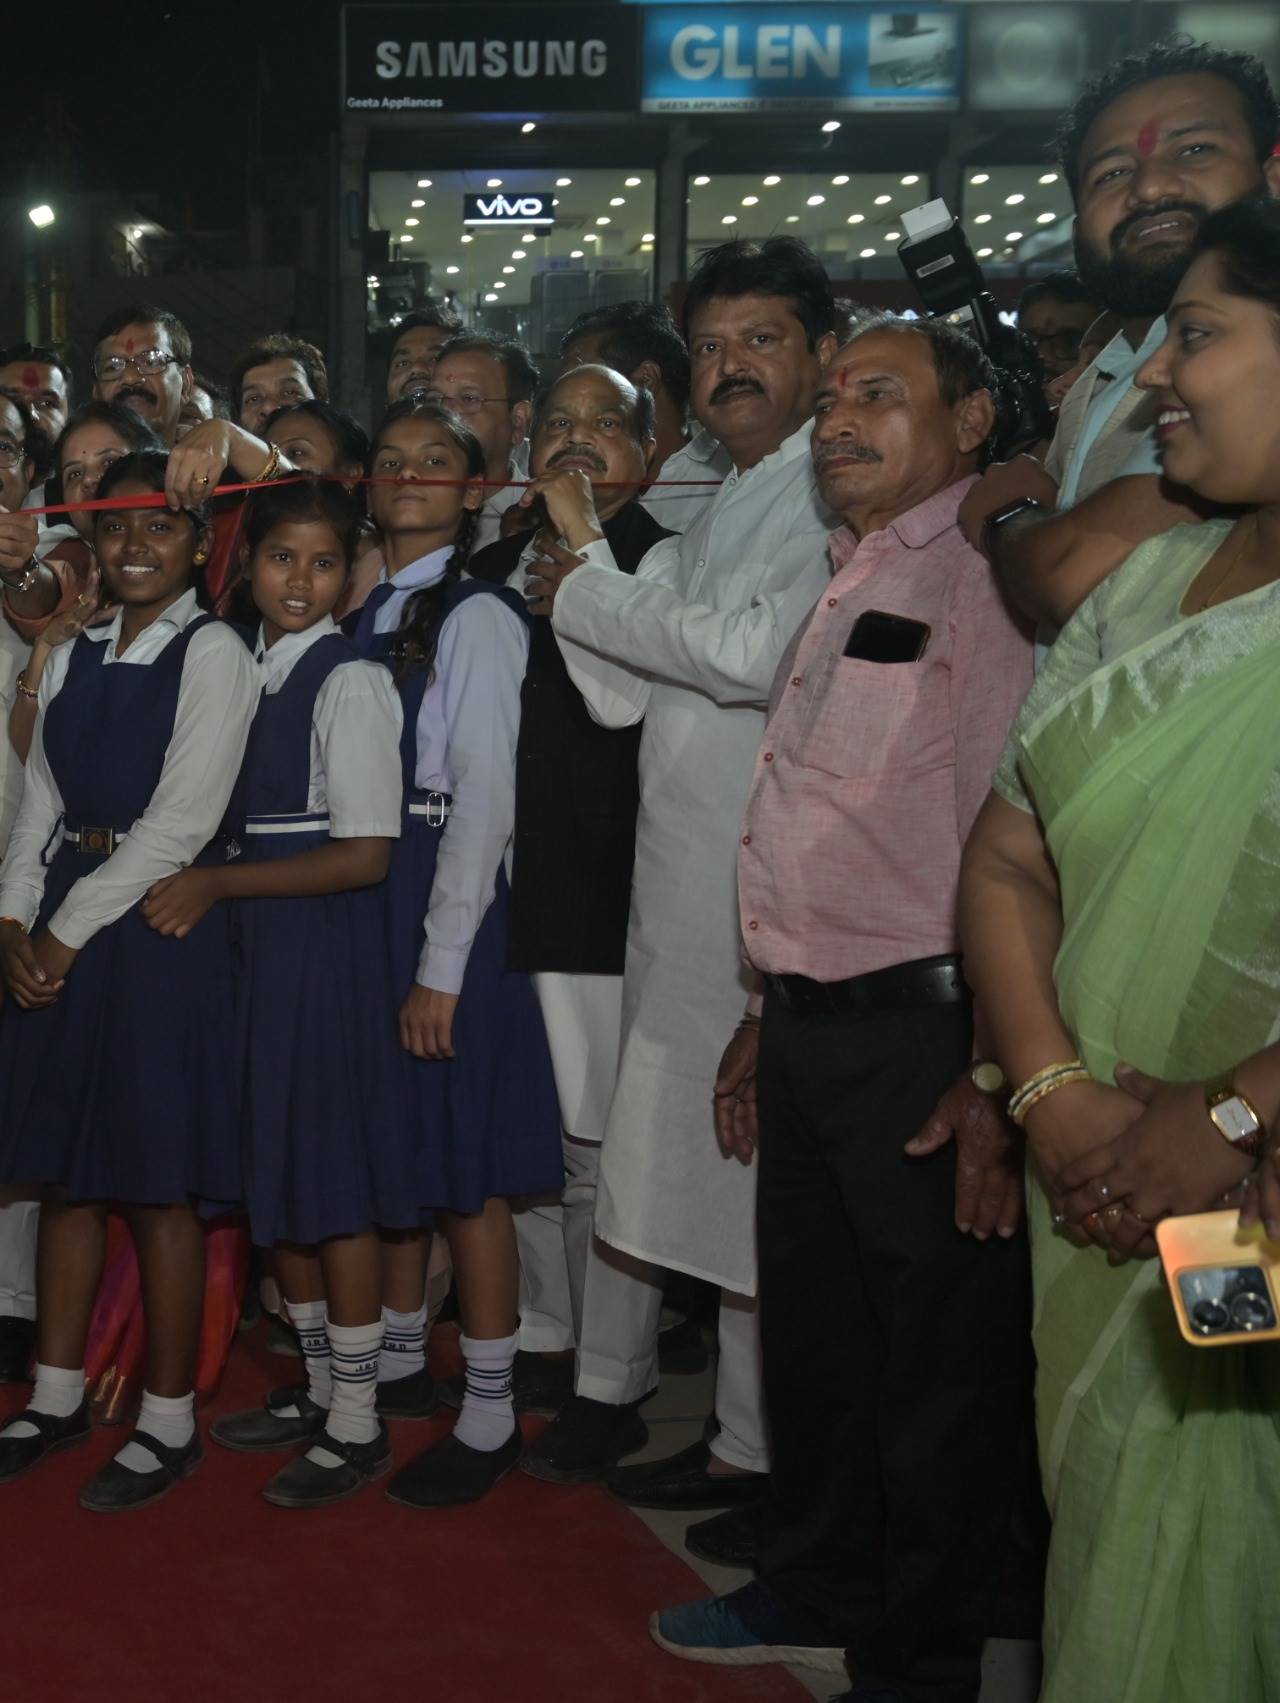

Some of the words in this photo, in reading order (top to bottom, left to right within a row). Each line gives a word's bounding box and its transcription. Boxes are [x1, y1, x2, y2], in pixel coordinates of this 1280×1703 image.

[376, 39, 608, 79] SAMSUNG
[670, 24, 842, 80] GLEN
[347, 97, 379, 108] Geeta
[381, 96, 444, 110] Appliances
[476, 194, 543, 216] vivo
